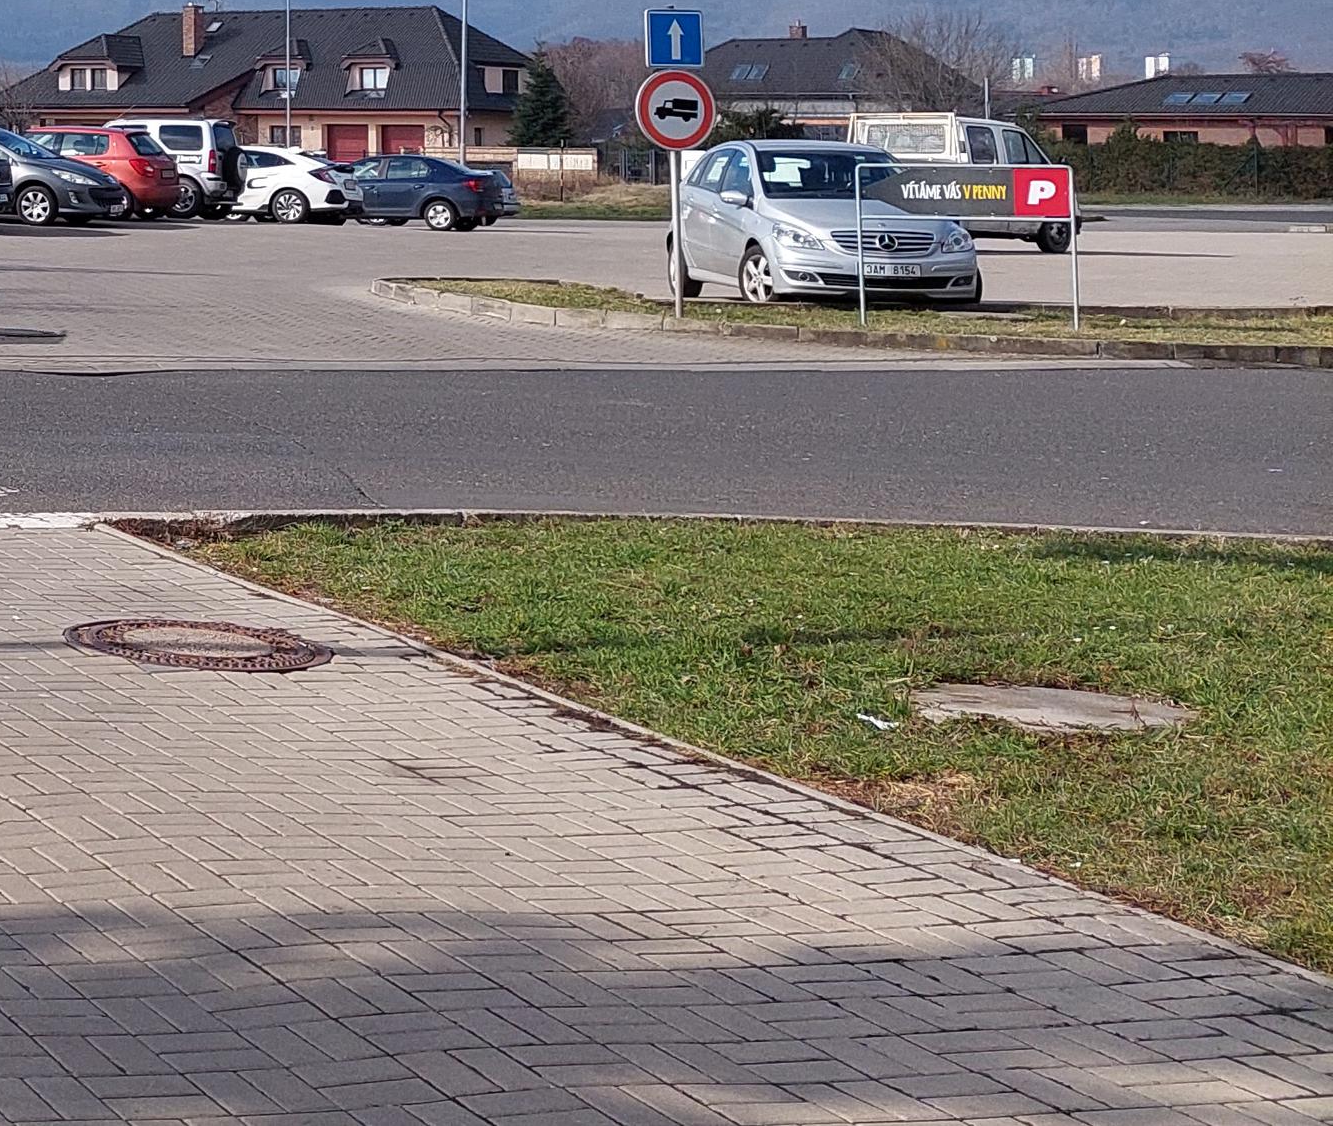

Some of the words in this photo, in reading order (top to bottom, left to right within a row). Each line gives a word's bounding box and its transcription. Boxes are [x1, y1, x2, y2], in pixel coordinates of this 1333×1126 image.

[901, 181, 941, 200] VÍTÁME
[943, 180, 962, 200] VÁS
[962, 184, 971, 200] V
[973, 185, 1007, 200] PENNY
[1026, 180, 1056, 205] P
[866, 264, 886, 275] 3AM
[893, 265, 916, 275] 8154
